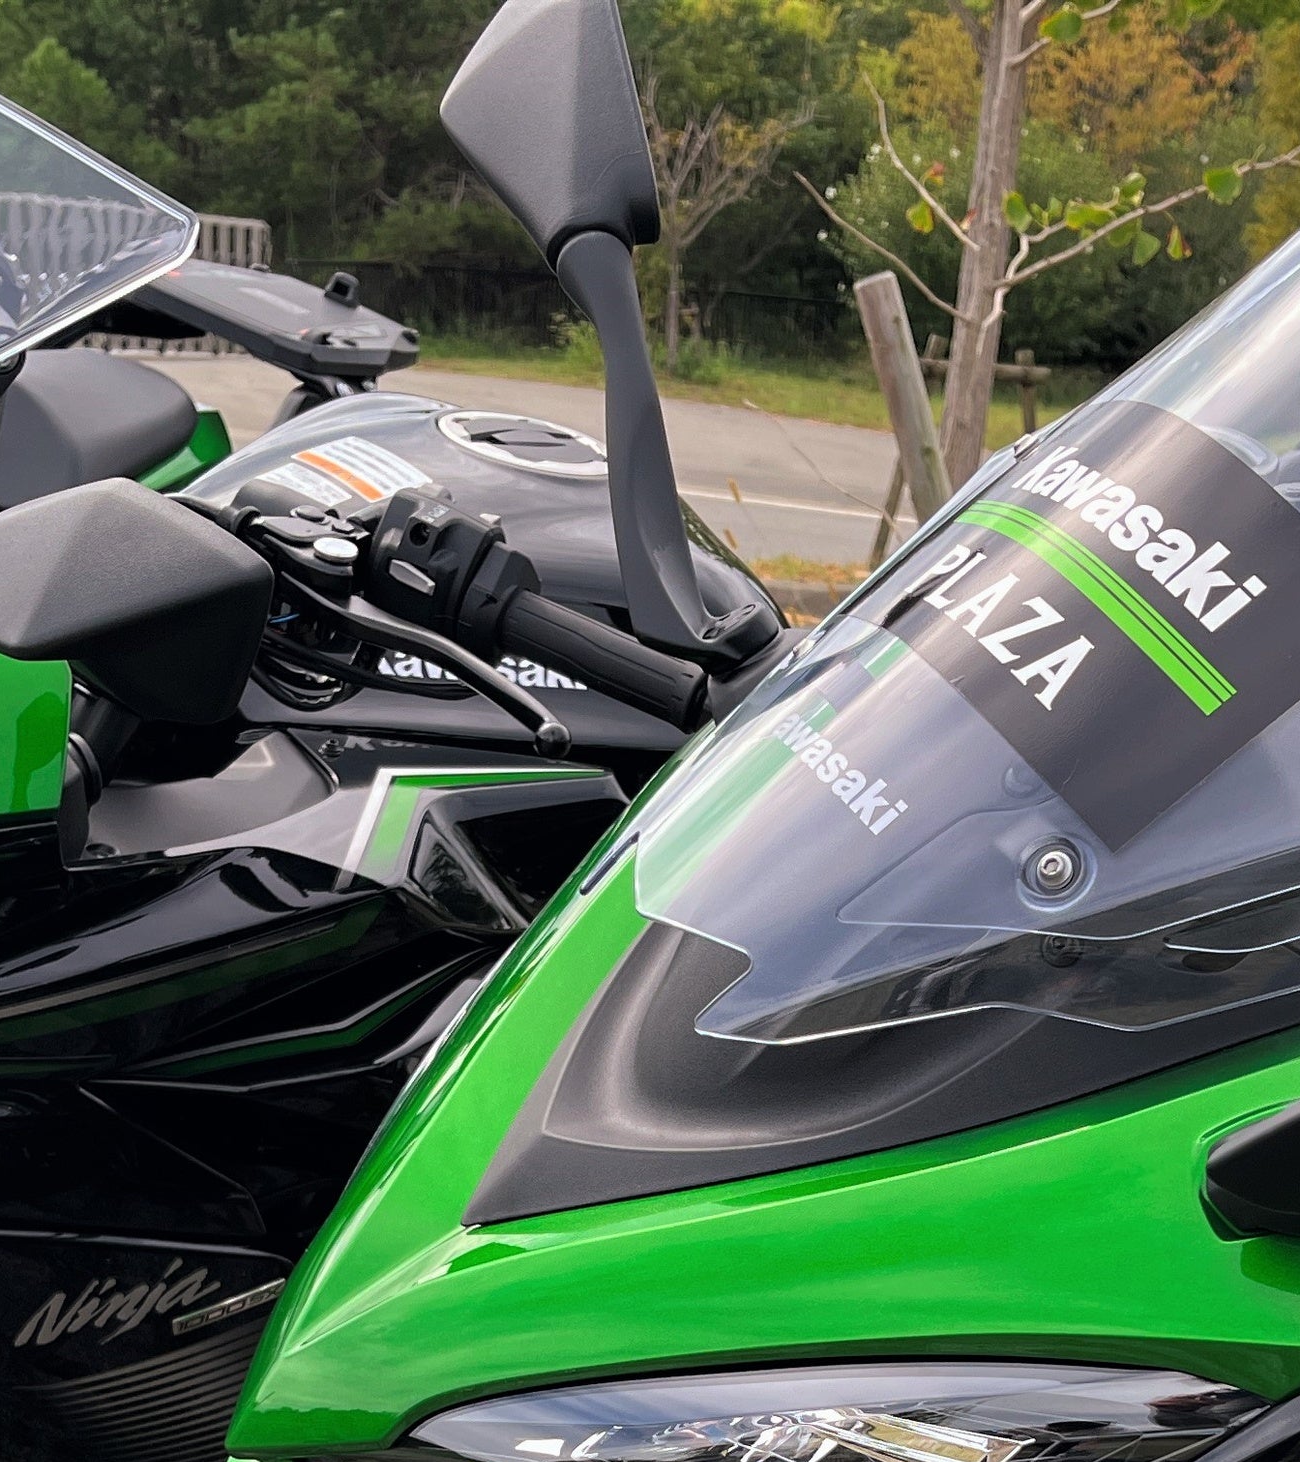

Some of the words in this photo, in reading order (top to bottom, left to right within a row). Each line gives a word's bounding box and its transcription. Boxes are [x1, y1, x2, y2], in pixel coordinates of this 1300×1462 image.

[1011, 445, 1268, 634] Kawasaki
[905, 543, 1095, 712] PLAZA
[13, 1257, 221, 1348] Ninja
